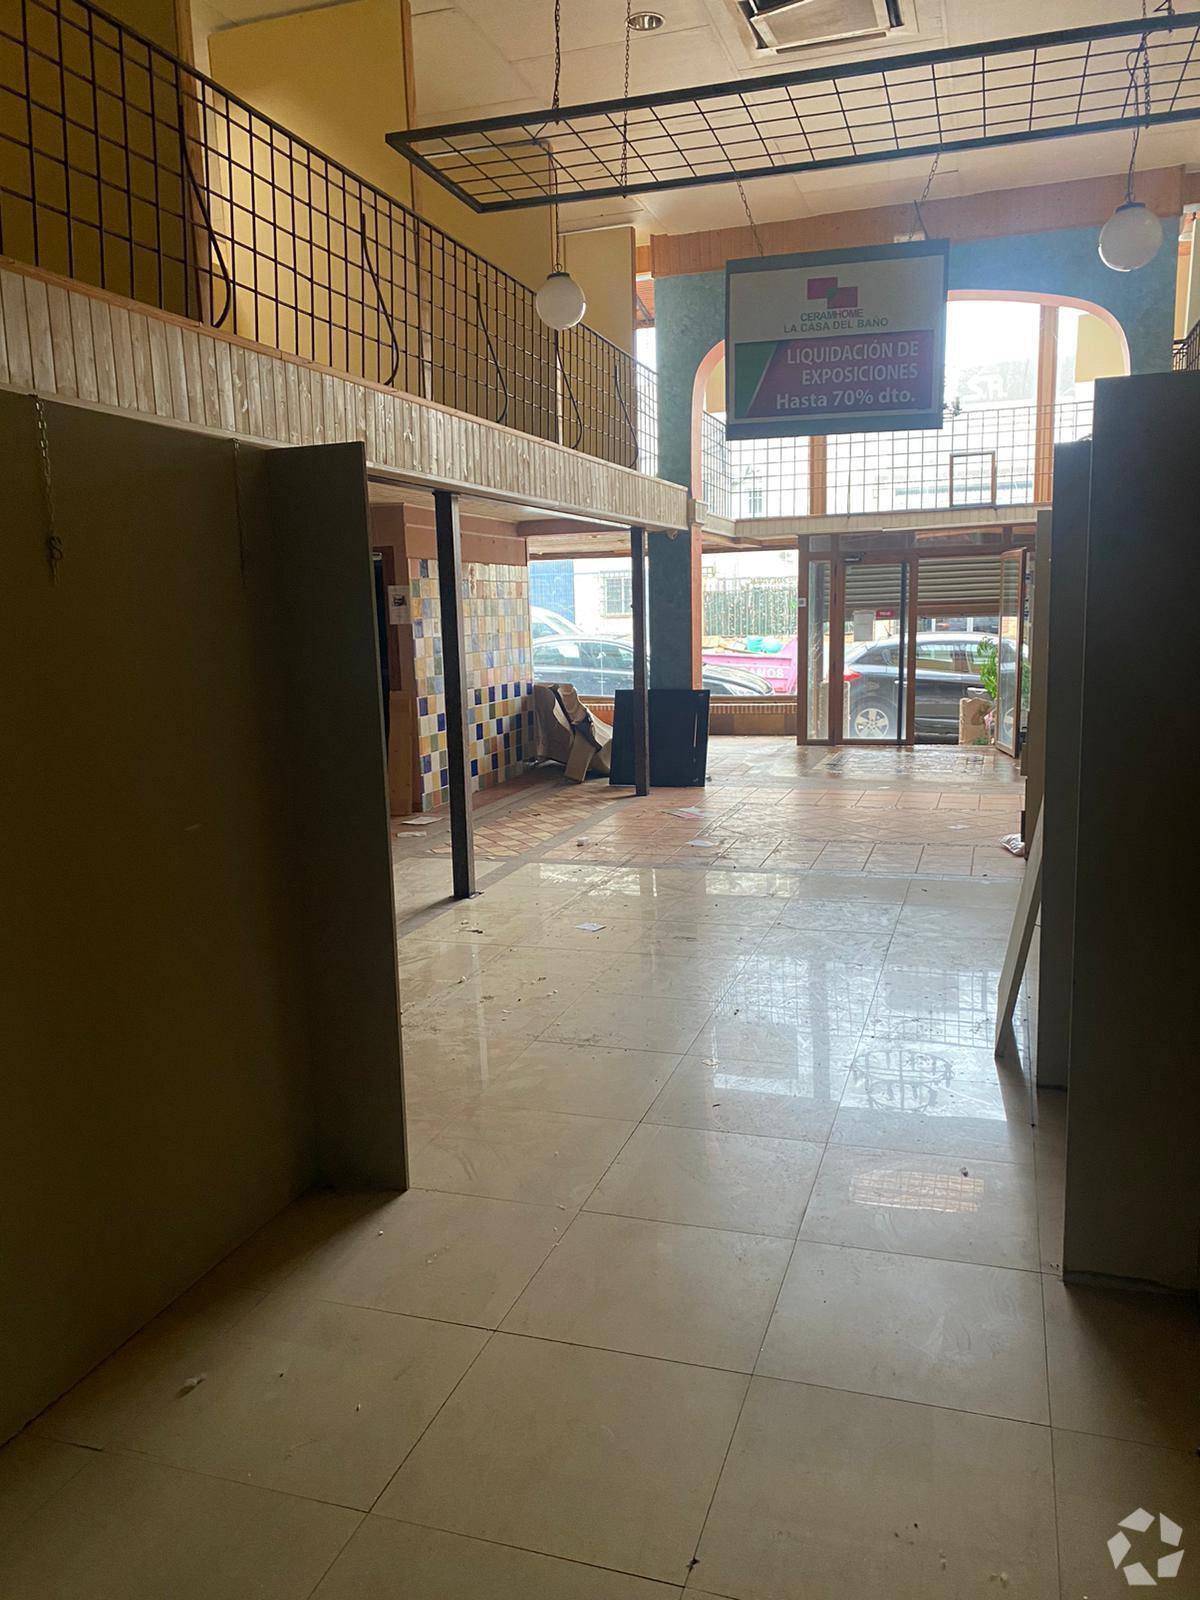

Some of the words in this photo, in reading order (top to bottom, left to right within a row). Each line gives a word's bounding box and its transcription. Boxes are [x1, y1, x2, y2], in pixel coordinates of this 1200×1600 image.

[784, 324, 798, 334] LA
[801, 322, 830, 333] CASA
[833, 320, 854, 330] DEL
[857, 317, 889, 329] BAÑO
[800, 308, 864, 322] CERAMHOME
[787, 340, 894, 366] LIQUIDACIÓN
[897, 341, 920, 357] DE
[802, 363, 919, 385] EXPOSICIONES
[777, 393, 828, 410] Hasta
[833, 388, 874, 407] 70%
[878, 387, 916, 404] dto.
